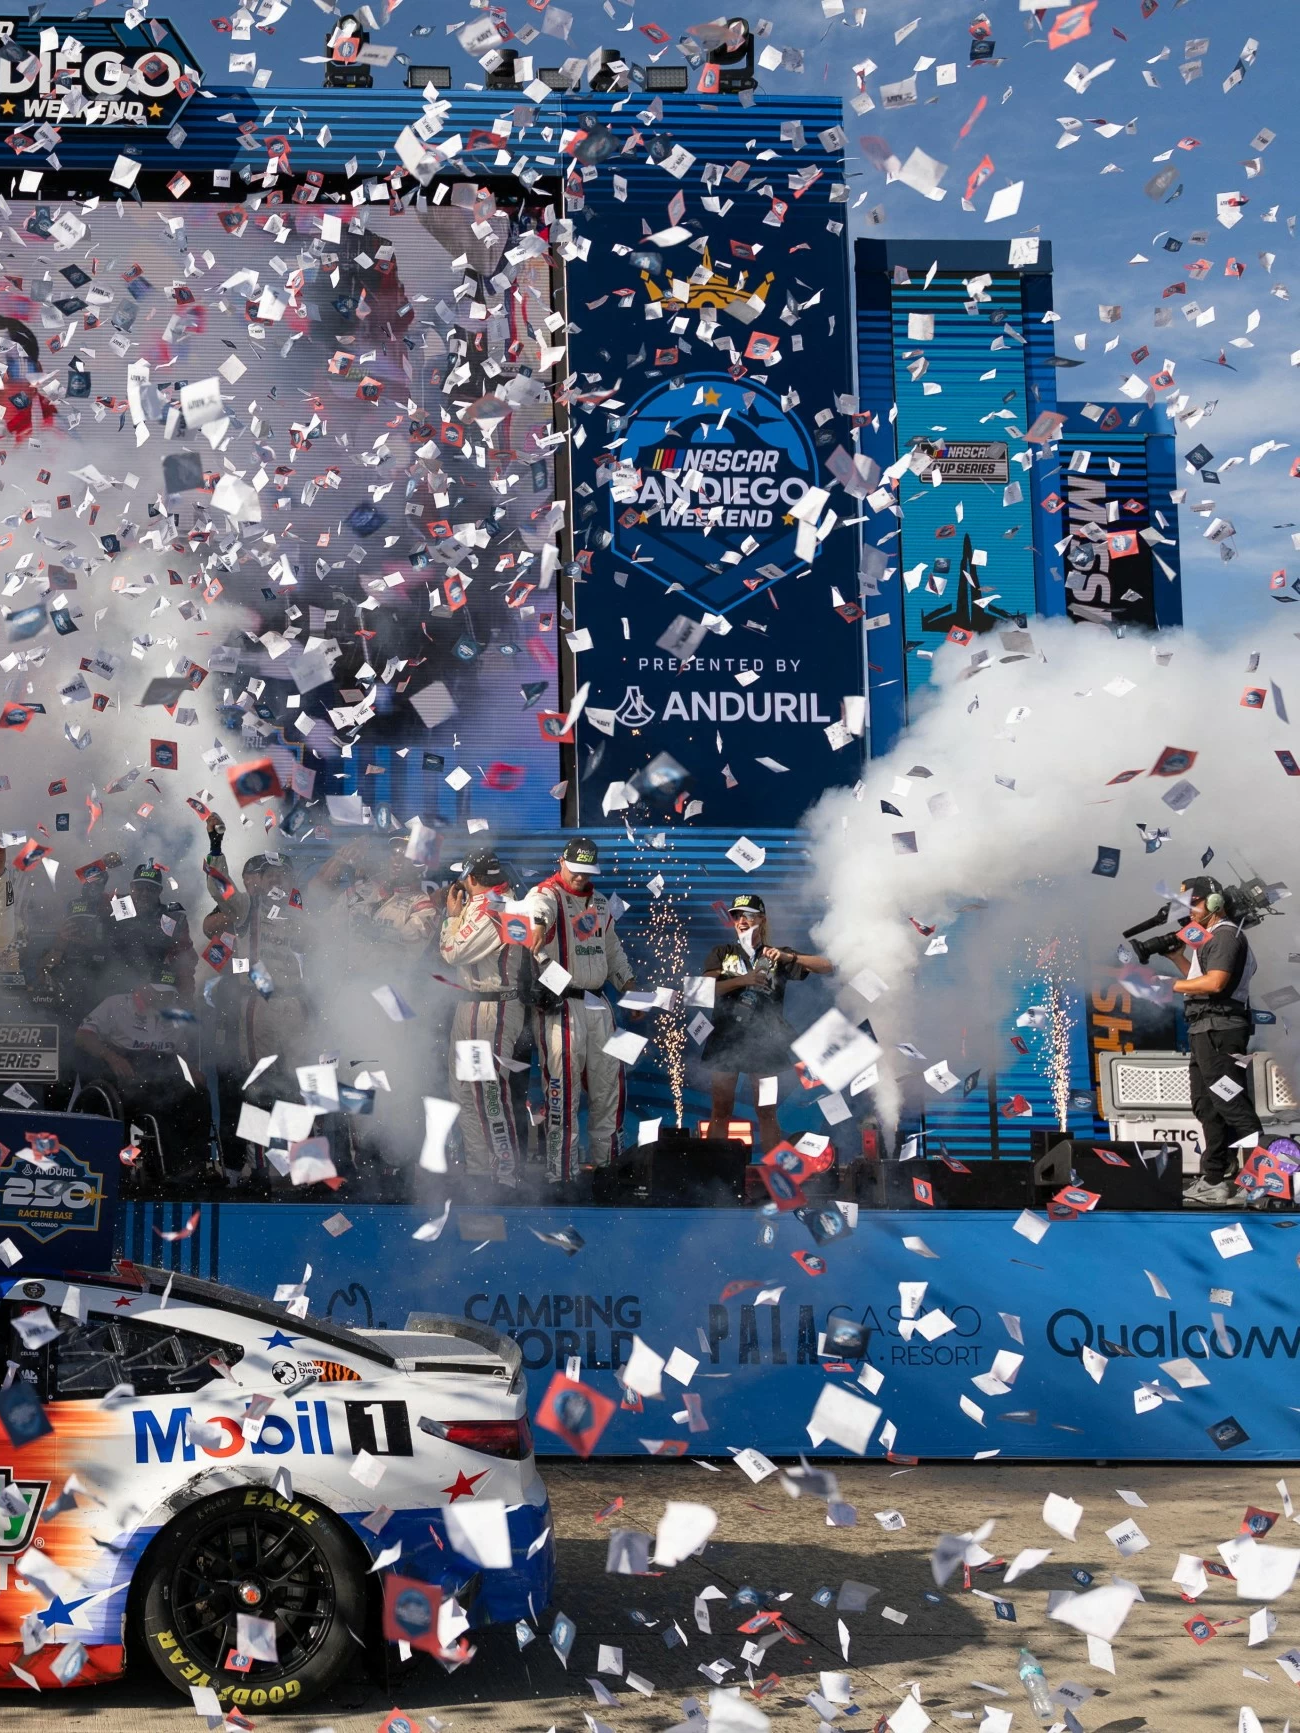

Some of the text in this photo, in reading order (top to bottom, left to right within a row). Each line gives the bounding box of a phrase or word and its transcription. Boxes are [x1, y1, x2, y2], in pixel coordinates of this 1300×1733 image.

[0, 51, 182, 97] DIEGO
[682, 448, 780, 473] NASCAR
[955, 462, 997, 475] SERIES
[698, 477, 810, 506] DIEGO
[639, 658, 801, 672] PRESENTED BY
[662, 691, 831, 723] ANDURIL
[550, 1078, 563, 1114] Mobil
[1153, 1129, 1199, 1142] RTIC
[34, 1166, 78, 1178] ANDURIL
[2, 1177, 92, 1209] 250
[18, 1209, 74, 1220] RACE THE BASE
[463, 1293, 641, 1330] CAMPING
[707, 1303, 820, 1366] PALA
[296, 1360, 312, 1368] San
[512, 1330, 642, 1371] ORLD
[892, 1345, 983, 1367] RESORT
[298, 1367, 323, 1376] Diego
[132, 1400, 335, 1464] Mobil
[243, 1490, 320, 1526] EAGLE
